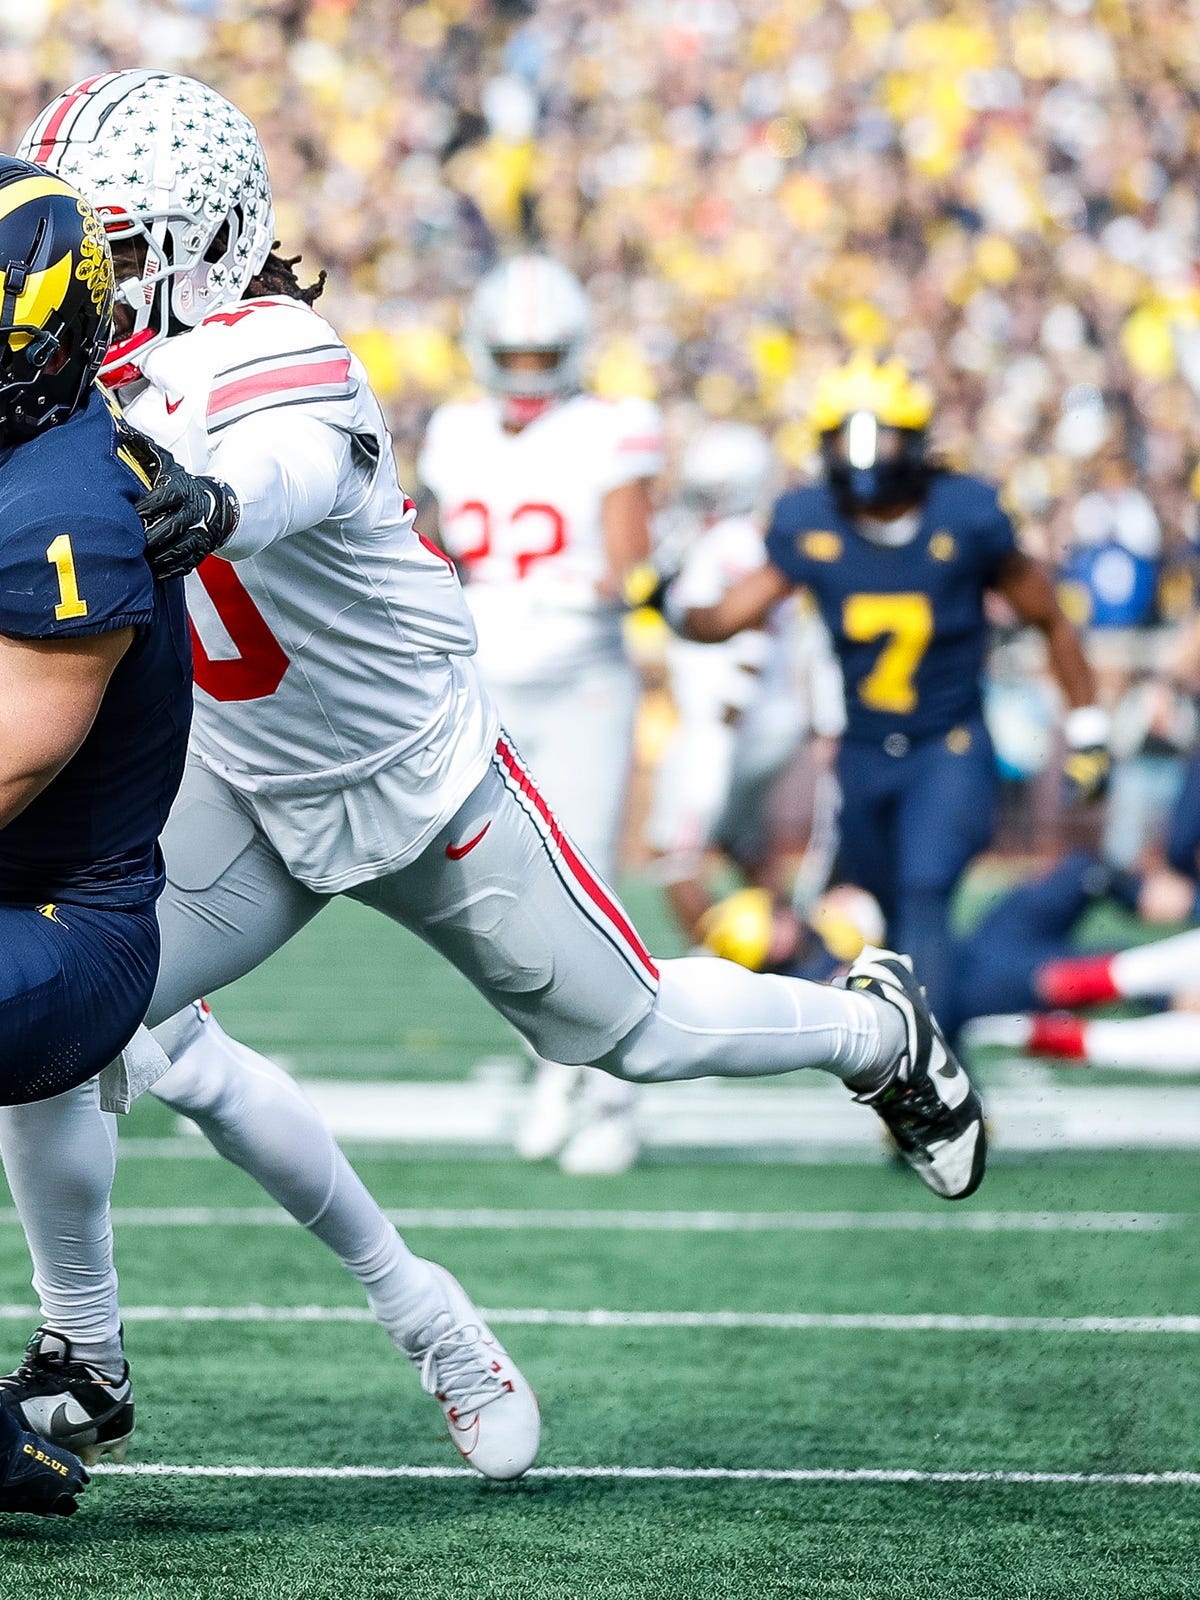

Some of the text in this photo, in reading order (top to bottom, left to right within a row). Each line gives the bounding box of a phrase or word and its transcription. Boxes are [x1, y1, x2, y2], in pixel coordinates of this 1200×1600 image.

[46, 534, 89, 621] 1
[444, 500, 566, 582] 22
[843, 592, 934, 714] 7
[34, 1450, 70, 1477] BLUE
